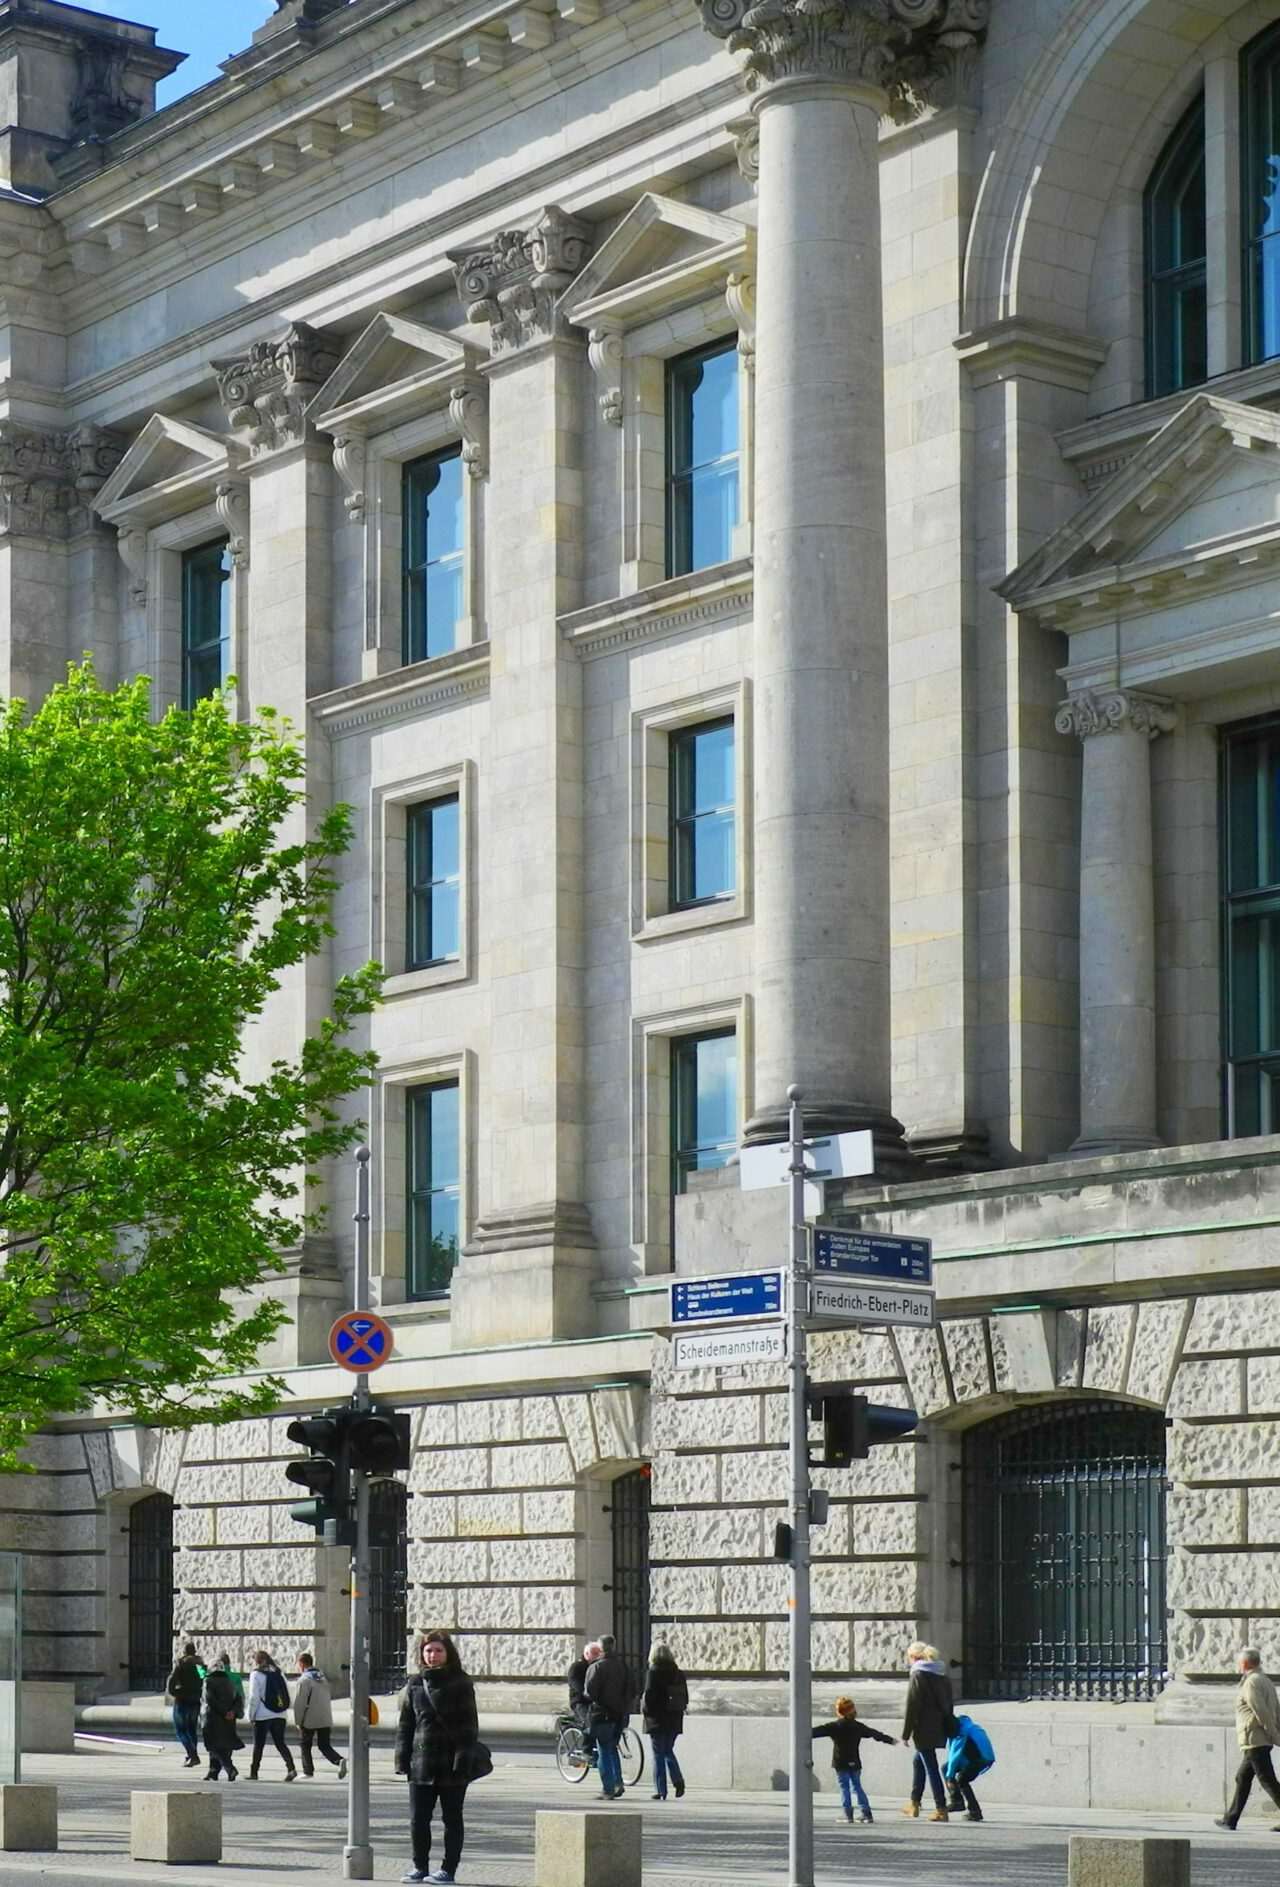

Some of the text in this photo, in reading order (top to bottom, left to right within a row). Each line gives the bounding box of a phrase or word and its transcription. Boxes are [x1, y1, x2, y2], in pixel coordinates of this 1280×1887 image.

[829, 1234, 853, 1244] Denkmal
[847, 1244, 870, 1253] Europas
[830, 1250, 879, 1262] Brandenburger Tor
[688, 1284, 706, 1292] Schloss
[816, 1290, 929, 1317] Friedrich-Ebert-Platz
[687, 1308, 733, 1318] Bundeskanzleramt
[680, 1336, 778, 1359] Scheidemannstraße
